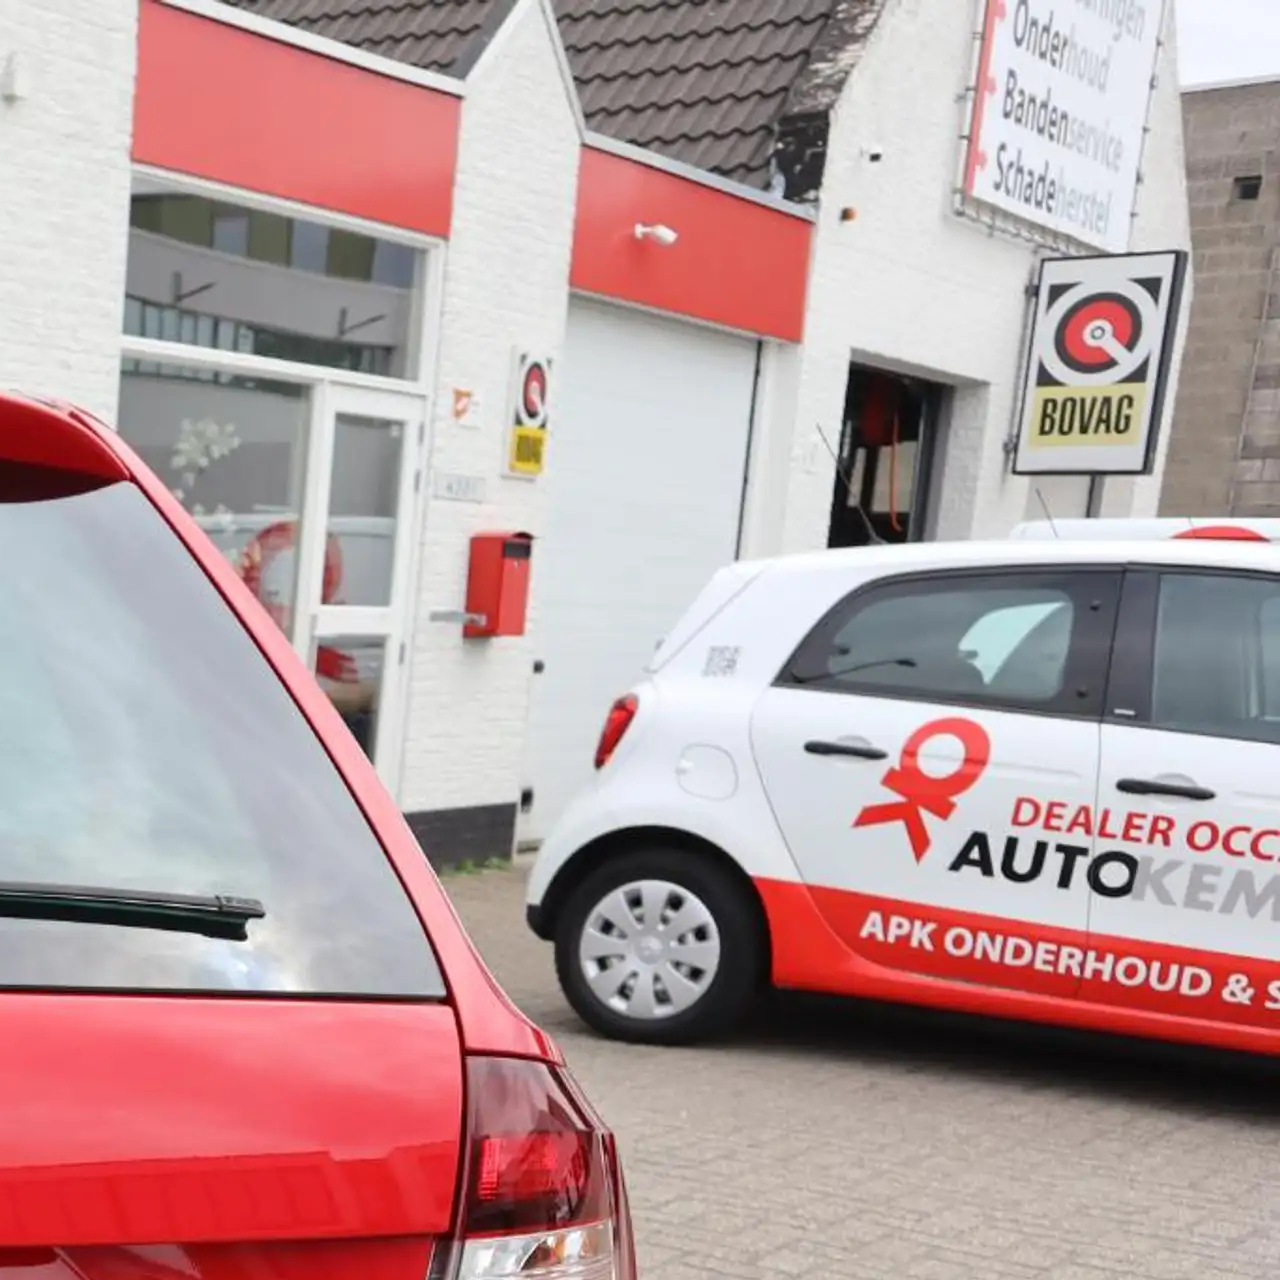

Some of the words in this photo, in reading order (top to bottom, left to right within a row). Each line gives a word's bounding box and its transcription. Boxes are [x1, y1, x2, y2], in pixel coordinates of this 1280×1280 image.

[1013, 0, 1113, 93] Onderhoud
[1002, 68, 1123, 173] Bandenservice
[992, 141, 1114, 234] Schadeherstel
[1038, 394, 1134, 436] BOVAG
[1011, 797, 1175, 847] DEALER
[1186, 820, 1280, 862] OCC
[860, 911, 936, 952] APK
[944, 927, 1212, 997] ONDERHOUD
[1221, 973, 1255, 1006] &
